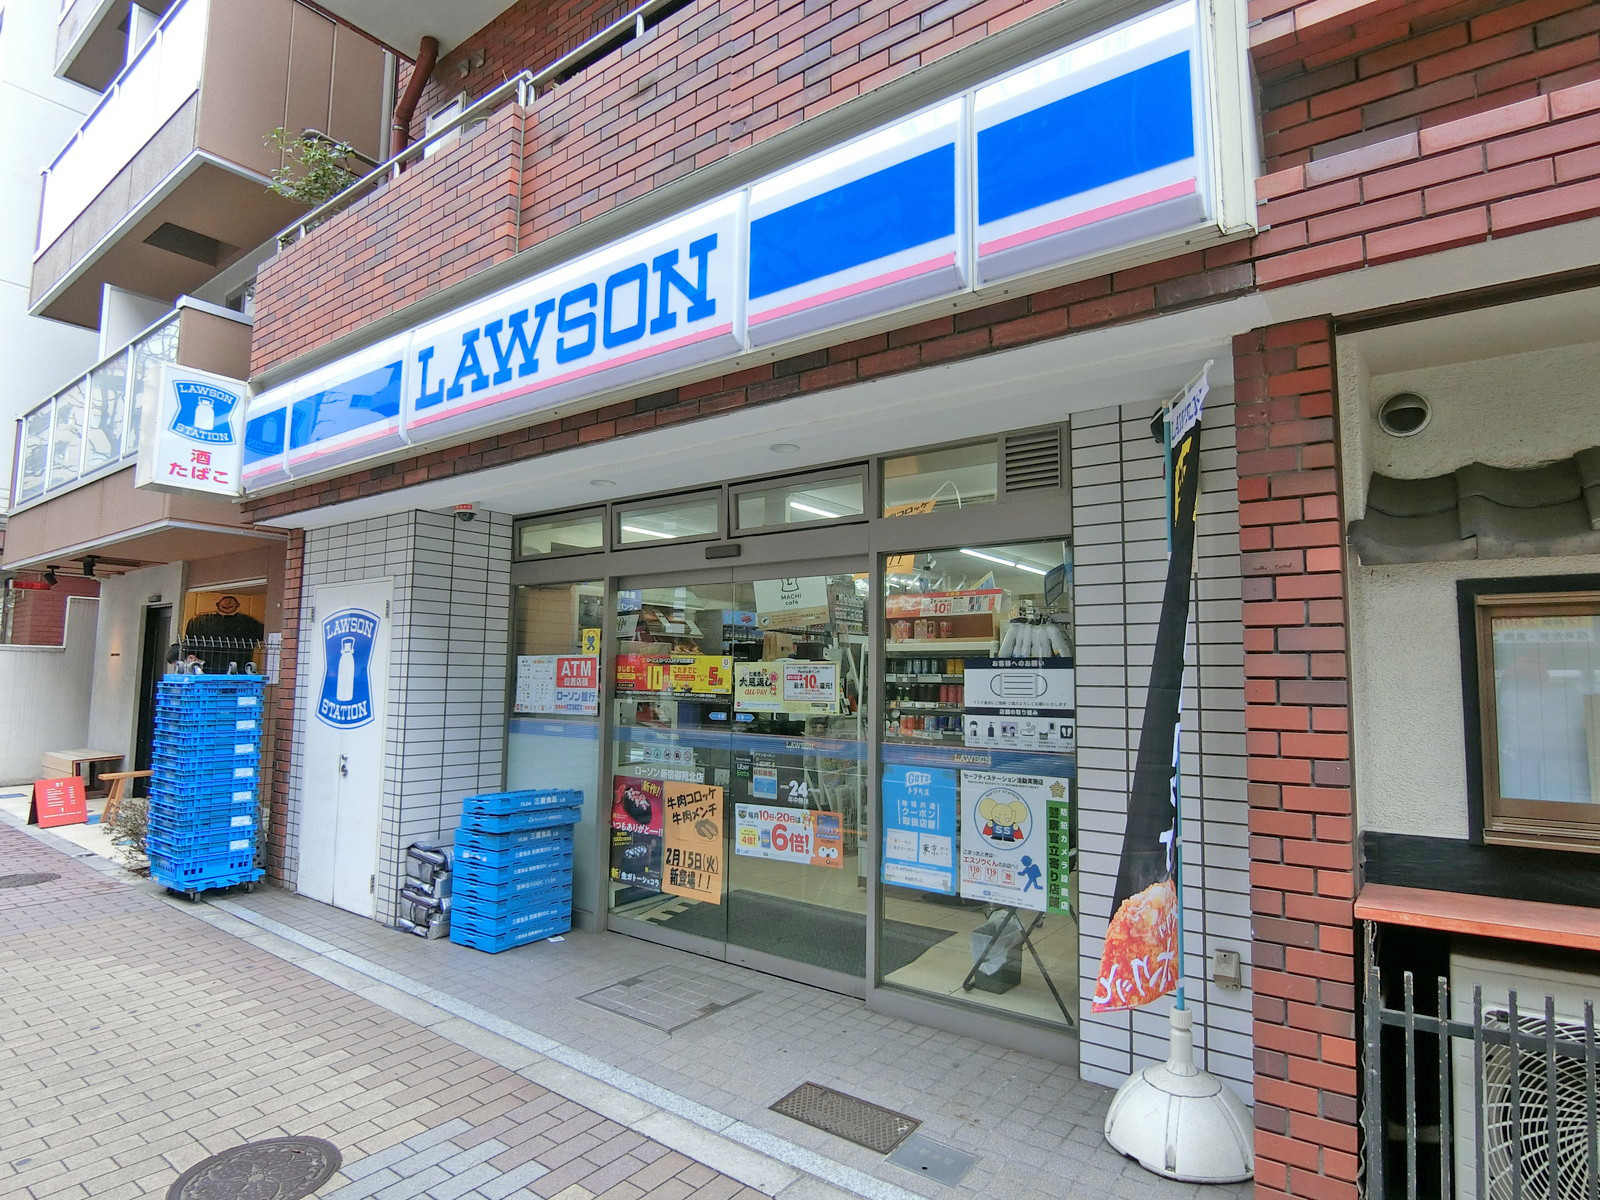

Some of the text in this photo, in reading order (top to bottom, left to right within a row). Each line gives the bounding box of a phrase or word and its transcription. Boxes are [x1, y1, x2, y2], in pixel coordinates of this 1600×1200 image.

[415, 233, 717, 411] LAWSON
[179, 384, 234, 404] LAWSON
[176, 423, 229, 441] STATION
[191, 449, 212, 466] 酒
[169, 462, 229, 485] たばこ
[325, 617, 374, 640] LAWSON
[560, 660, 592, 677] ATM
[991, 660, 1045, 668] お客様へのお願い
[556, 691, 596, 702] ローソン銀行
[321, 698, 368, 721] STATION
[785, 741, 815, 750] LAWSON
[954, 754, 992, 765] LAWSON
[635, 766, 704, 783] ローソン新宿御苑北店
[963, 773, 1044, 786] セーフティステーション活動実施店
[788, 780, 809, 798] 24
[908, 787, 930, 796] トラベル
[985, 790, 1021, 801] SAFETY STATION
[534, 795, 558, 805] 三菱食品
[667, 787, 717, 810] 牛肉コロッケ
[787, 796, 810, 804] 年中無休
[672, 803, 717, 825] 牛肉メンチ
[902, 807, 936, 818] クーポン
[902, 816, 936, 829] 取扱店舗
[995, 826, 1011, 835] SS
[771, 823, 810, 854] 6倍!
[922, 843, 939, 856] 東京
[1048, 806, 1060, 909] 警察官立寄り店舗
[665, 847, 719, 873] 2月15日(火)
[970, 865, 980, 873] 110
[986, 868, 997, 876] 119
[621, 871, 660, 887] 生ガトーショコラ
